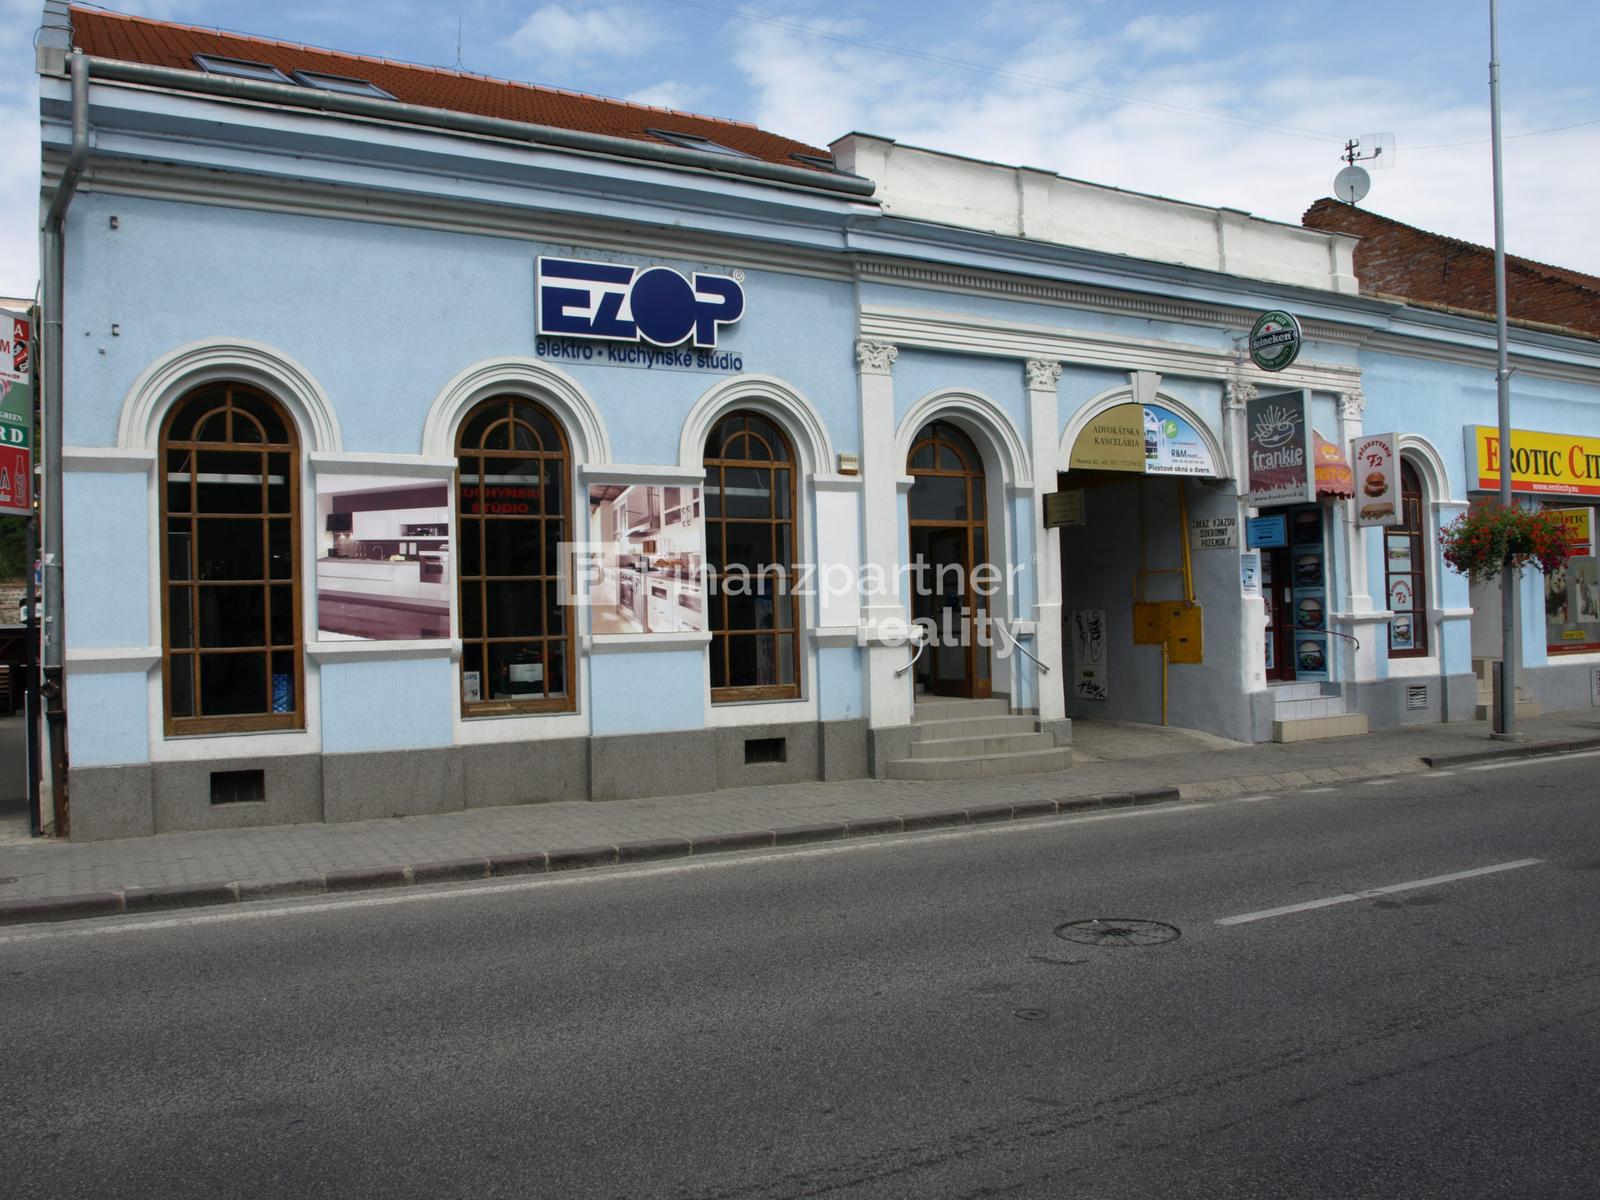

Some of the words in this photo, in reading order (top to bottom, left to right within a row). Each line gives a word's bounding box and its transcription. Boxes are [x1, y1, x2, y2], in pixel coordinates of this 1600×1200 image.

[536, 256, 745, 348] EZOP
[1252, 332, 1293, 350] Heineken
[536, 342, 593, 361] elektro
[1093, 425, 1140, 436] ADVOKÁTSKA
[1094, 437, 1140, 448] KANCELÁRIA
[1252, 445, 1304, 467] frankie
[461, 487, 541, 500] UCHYNSK
